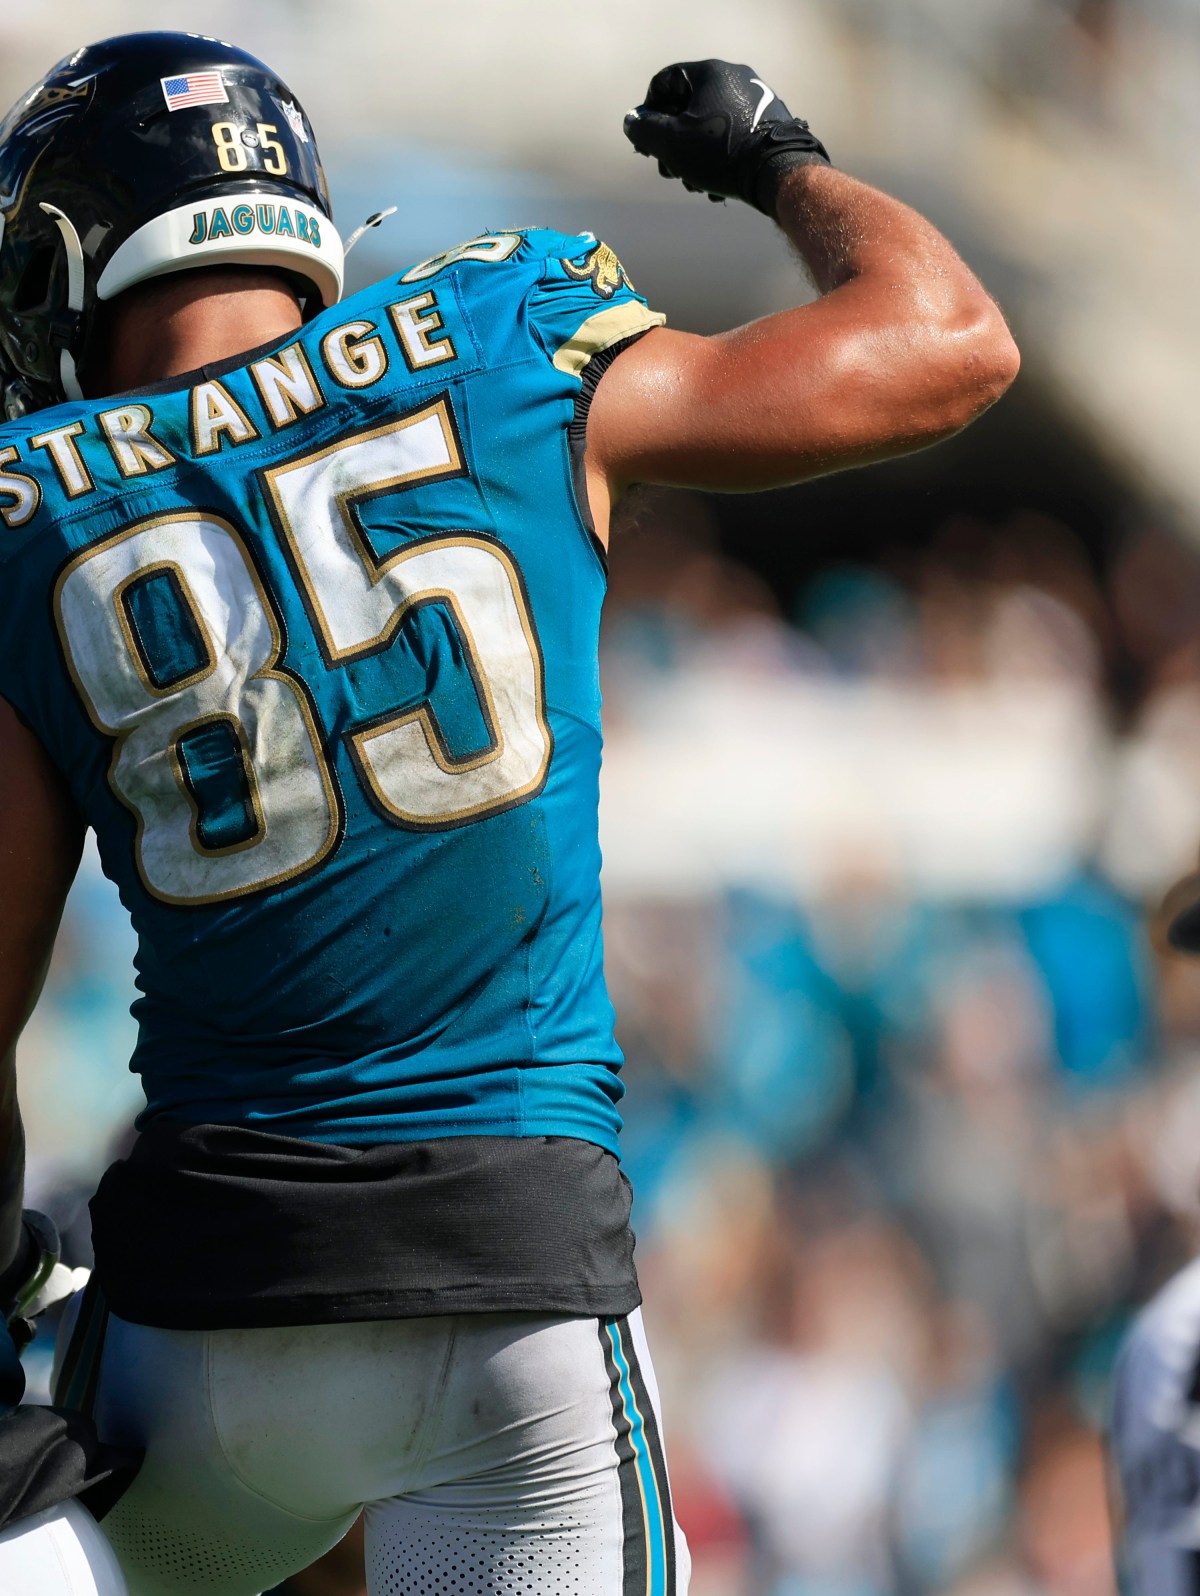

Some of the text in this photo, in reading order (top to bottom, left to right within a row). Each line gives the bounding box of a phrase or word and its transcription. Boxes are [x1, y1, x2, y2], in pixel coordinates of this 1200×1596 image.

[211, 121, 288, 176] 85
[189, 203, 322, 248] JAGUARS
[52, 390, 555, 906] 85
